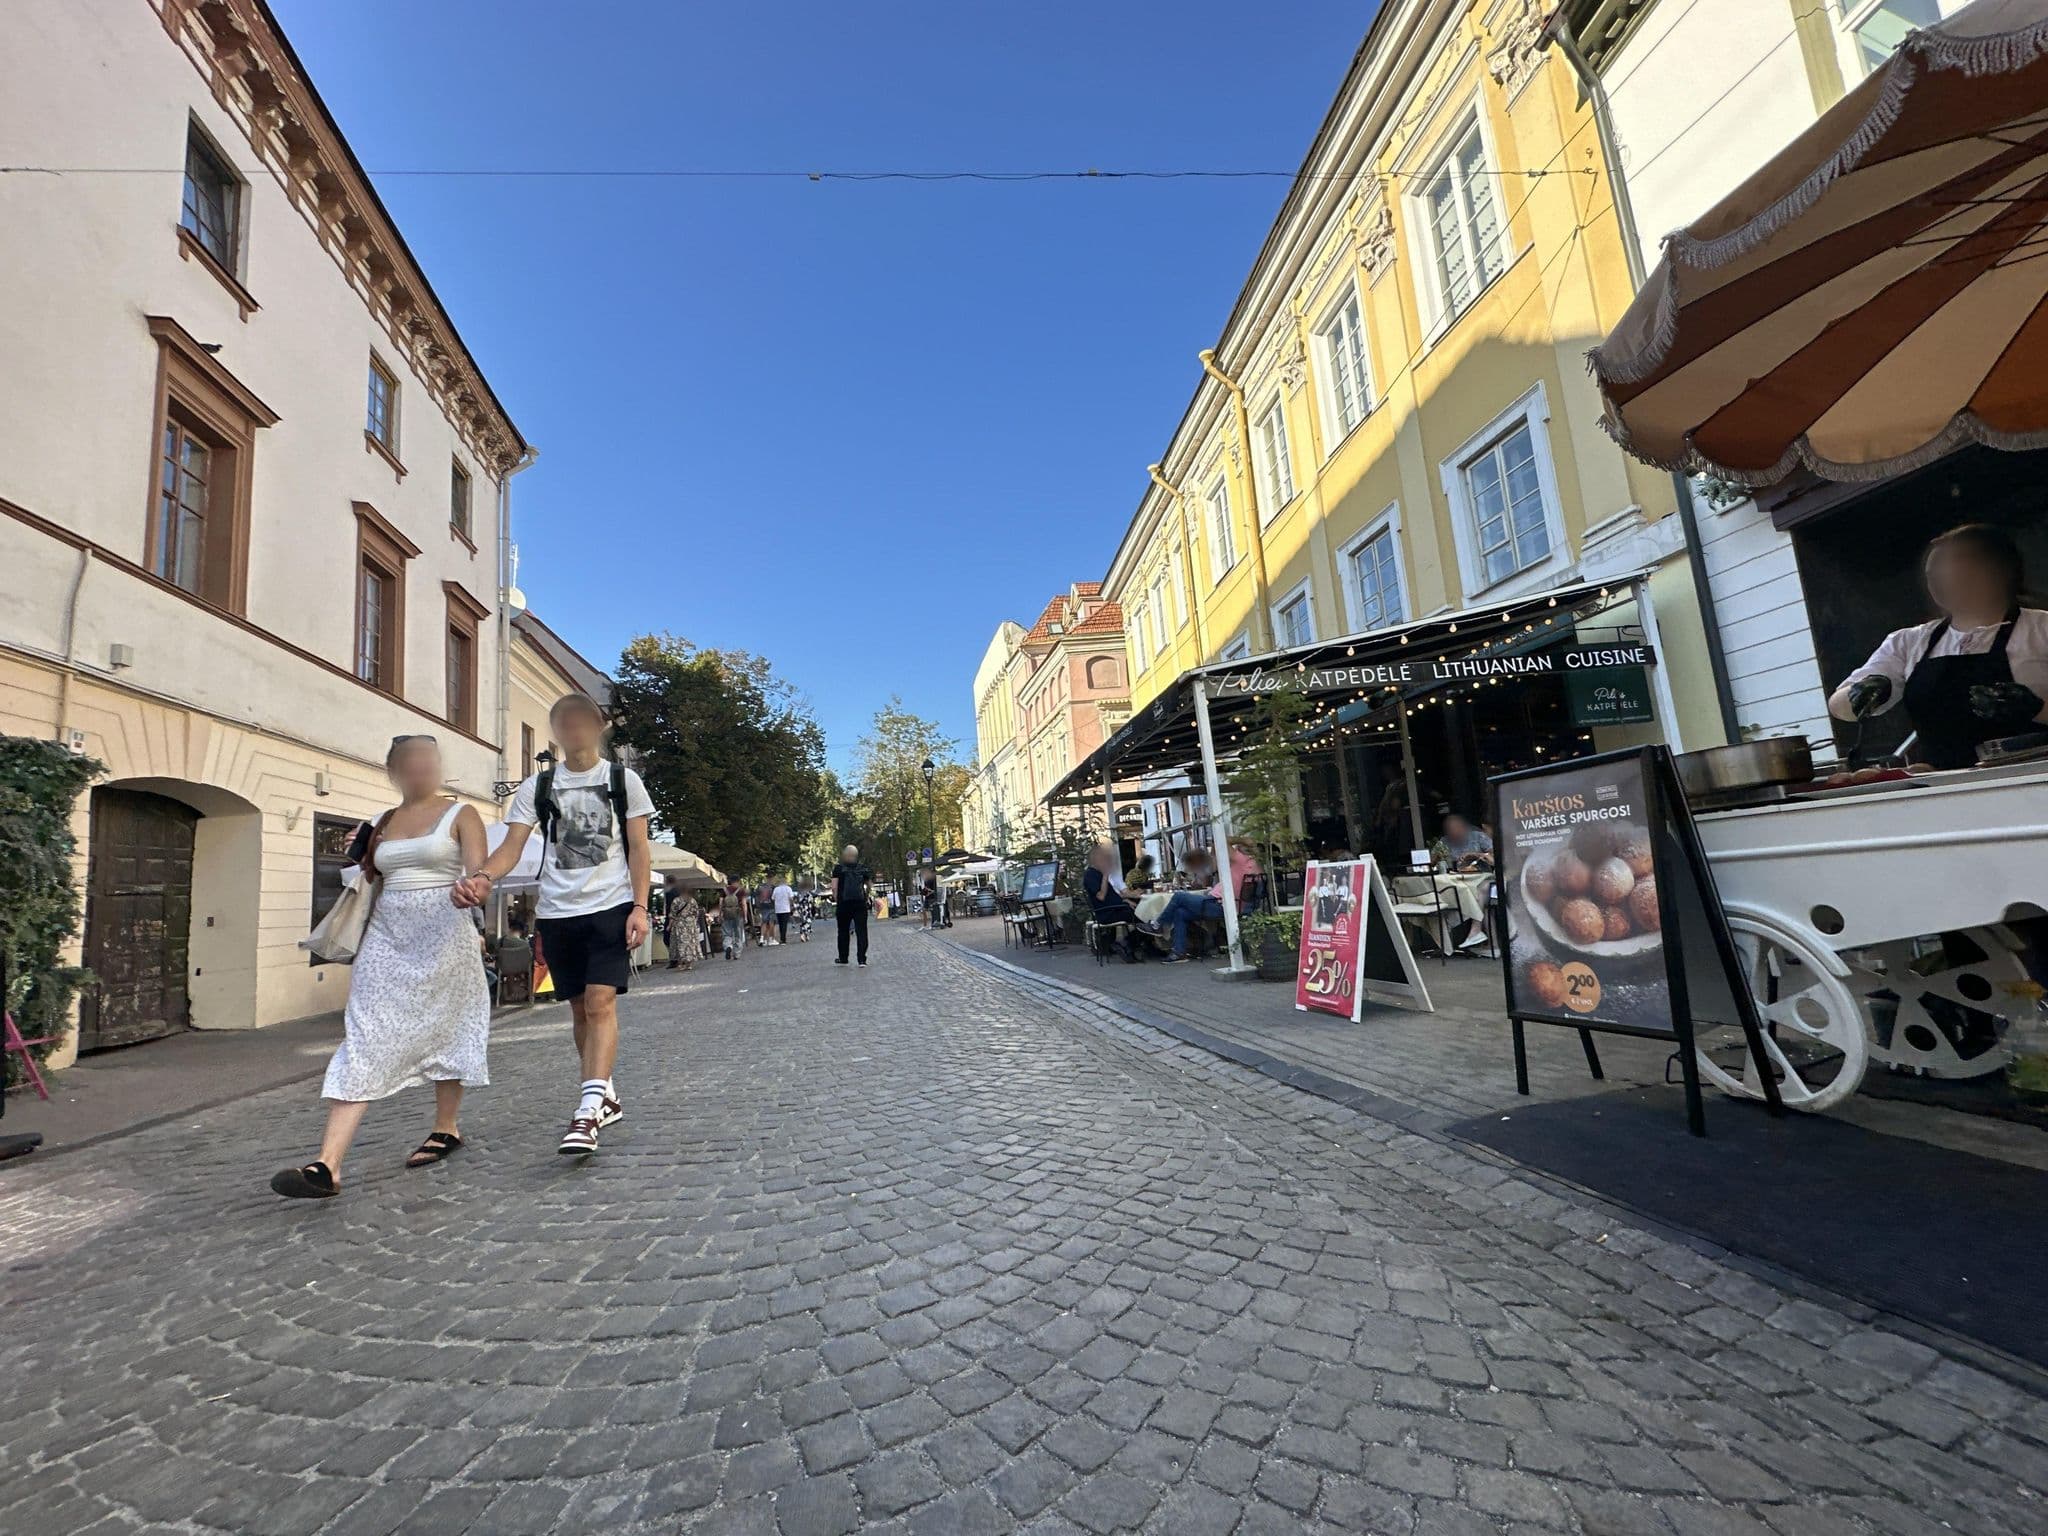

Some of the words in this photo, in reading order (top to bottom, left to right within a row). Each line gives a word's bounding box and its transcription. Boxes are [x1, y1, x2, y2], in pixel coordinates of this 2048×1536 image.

[1433, 655, 1552, 679] LITHUANIAN
[1565, 647, 1647, 669] CUISINE
[1512, 793, 1585, 820] Karštos
[1521, 812, 1567, 830] VARŠKĖS
[1569, 804, 1631, 824] SPURGOS!
[1302, 948, 1351, 998] -25%
